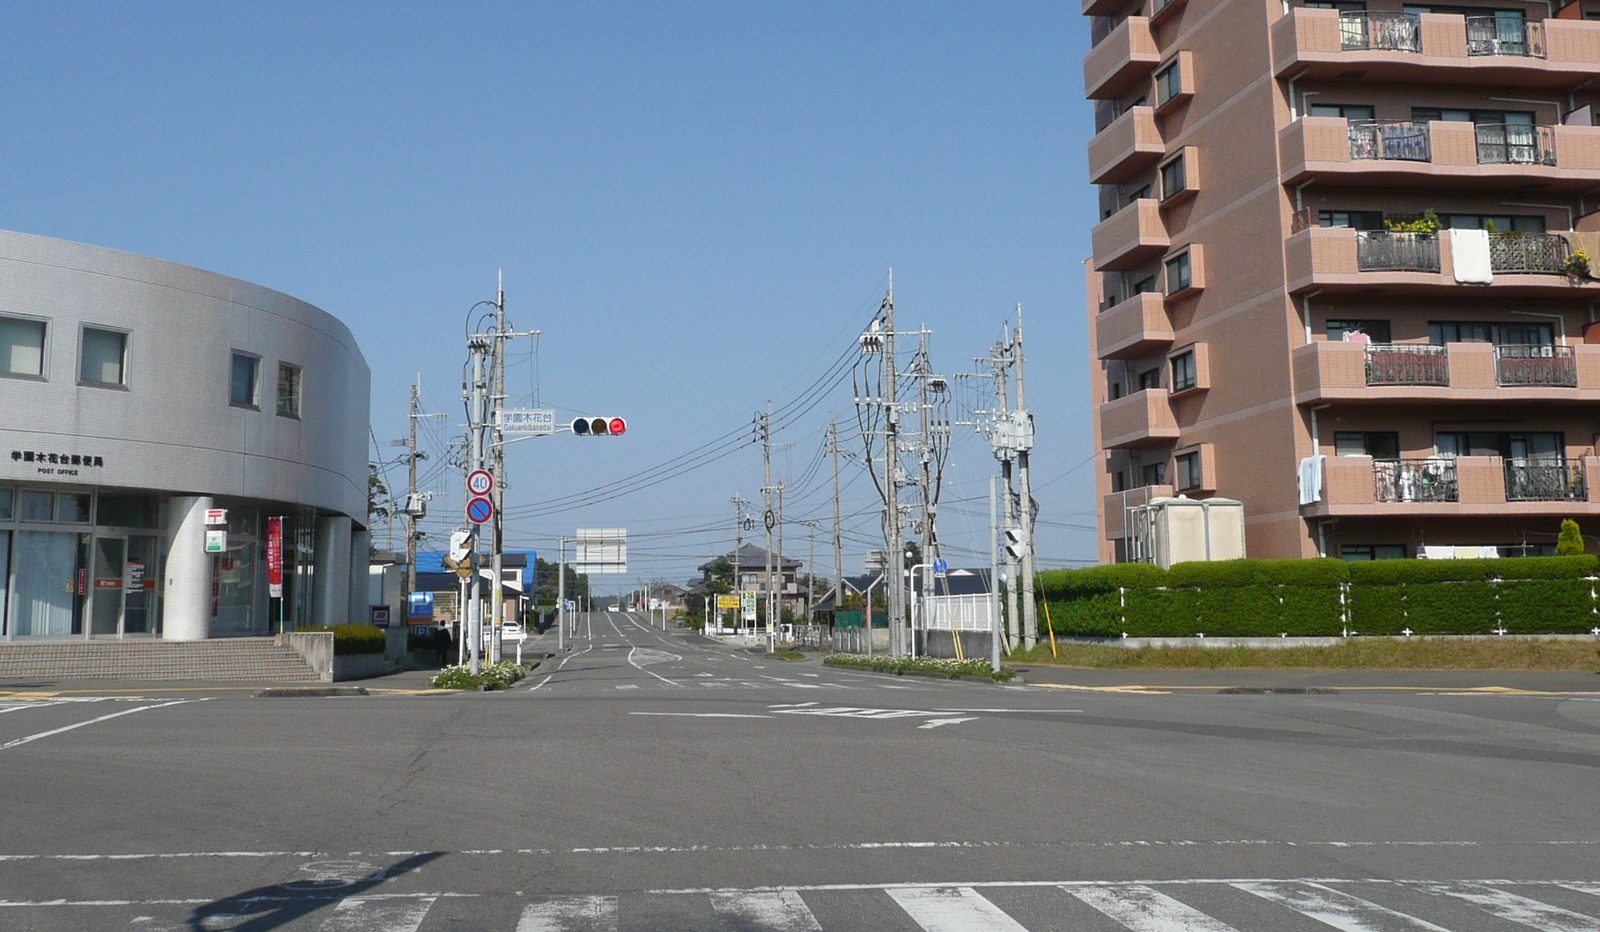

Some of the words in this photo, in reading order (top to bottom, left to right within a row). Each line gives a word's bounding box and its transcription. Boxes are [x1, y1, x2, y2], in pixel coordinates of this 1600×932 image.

[503, 412, 553, 423] 学園木花台
[37, 467, 55, 475] POST
[57, 468, 78, 476] OFFICE
[473, 476, 488, 490] 40
